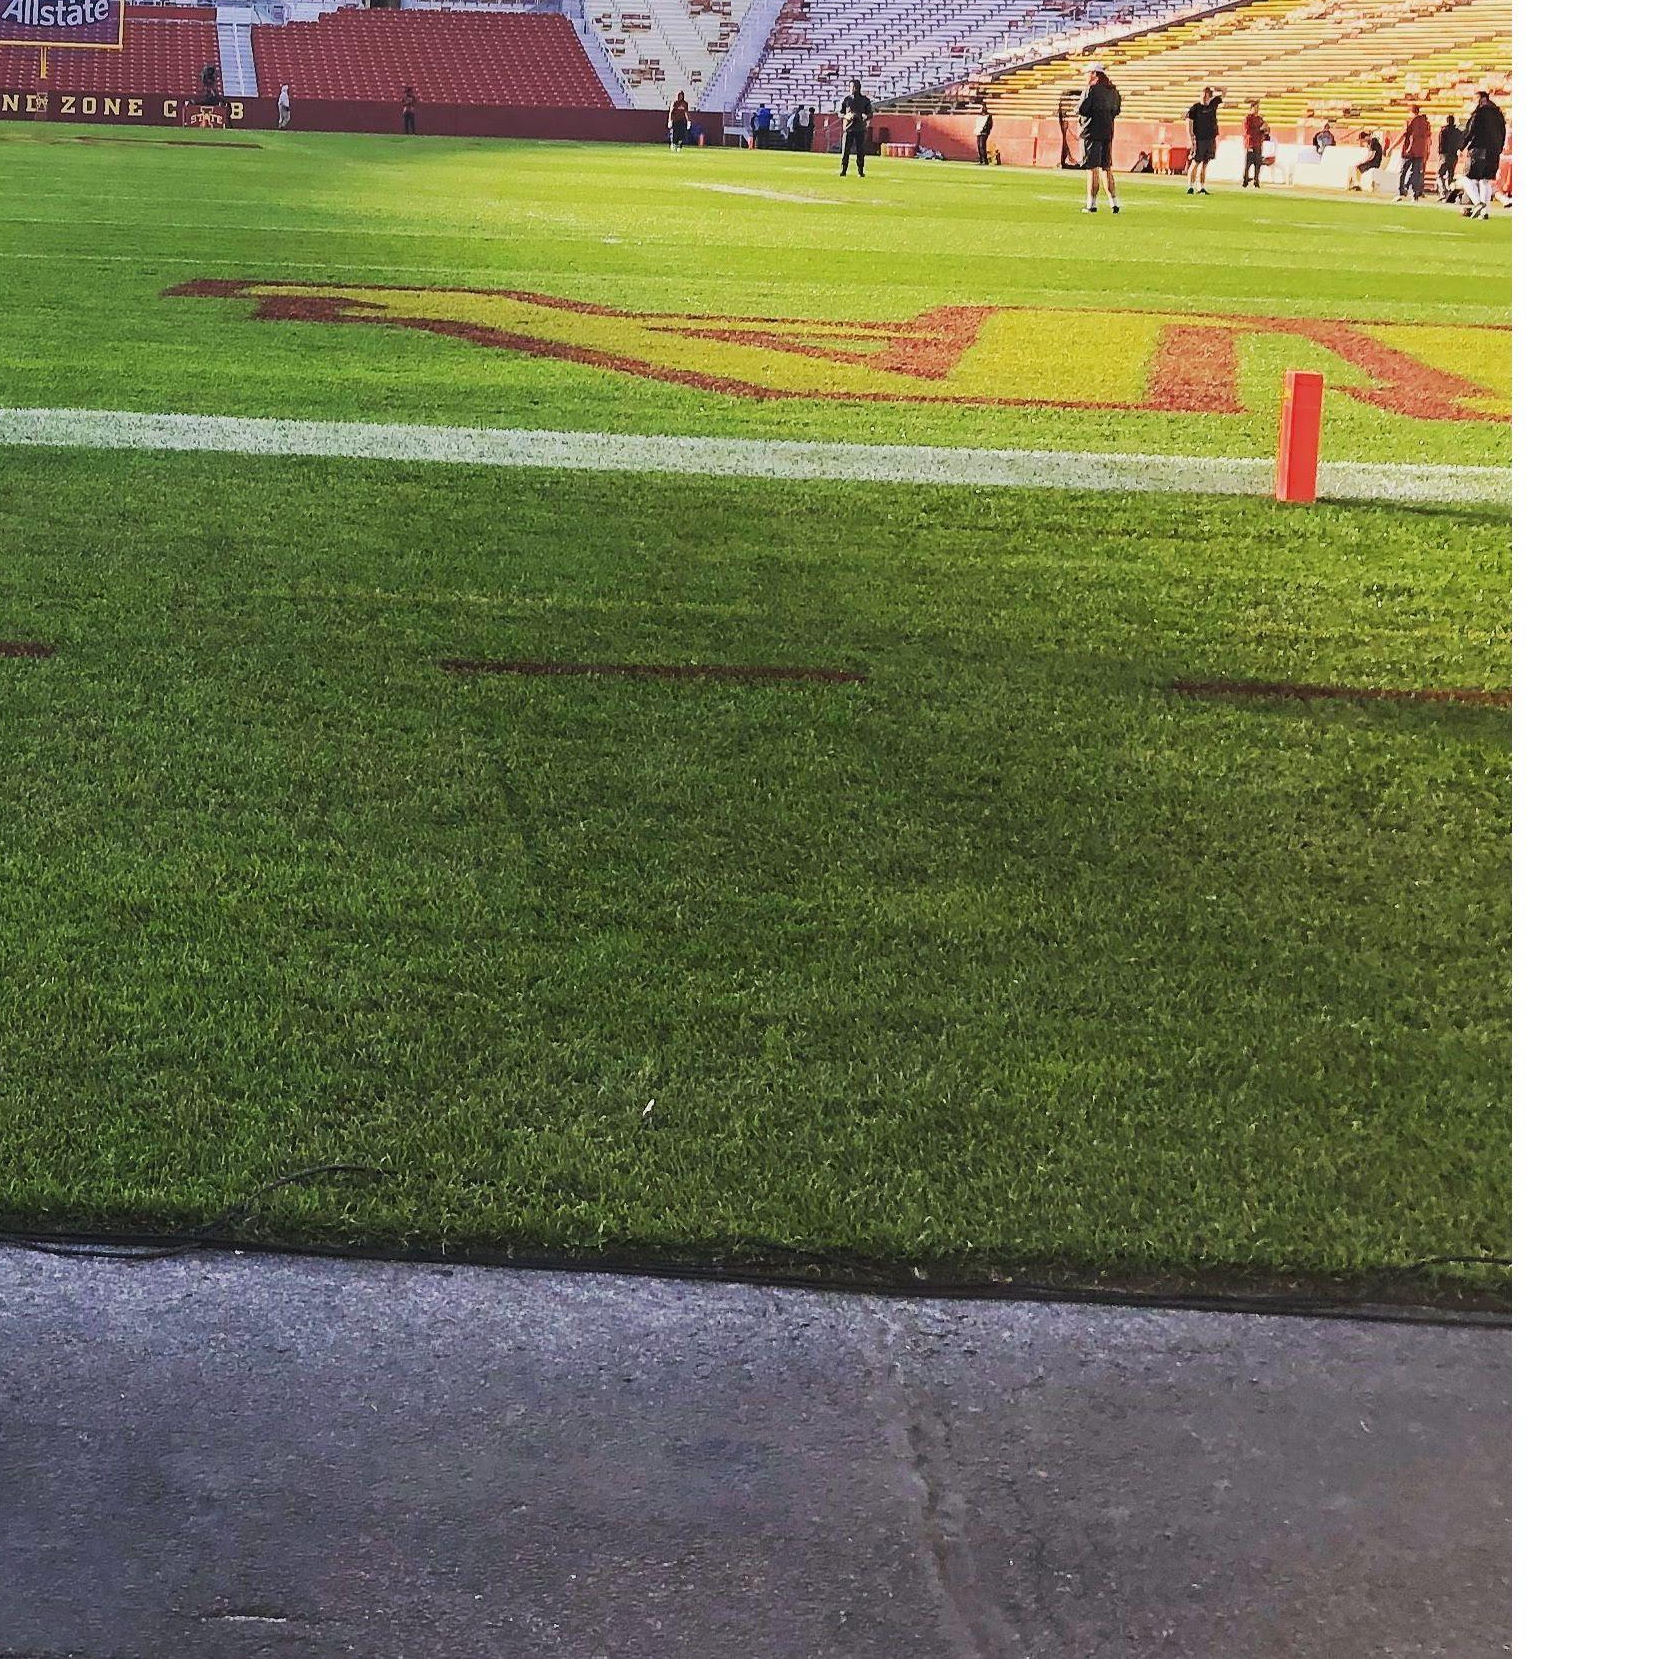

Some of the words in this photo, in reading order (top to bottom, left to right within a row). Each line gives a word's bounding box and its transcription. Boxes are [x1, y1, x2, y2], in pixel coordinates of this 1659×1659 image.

[60, 96, 143, 117] ZONE
[163, 100, 244, 120] CB
[190, 113, 224, 125] STATE
